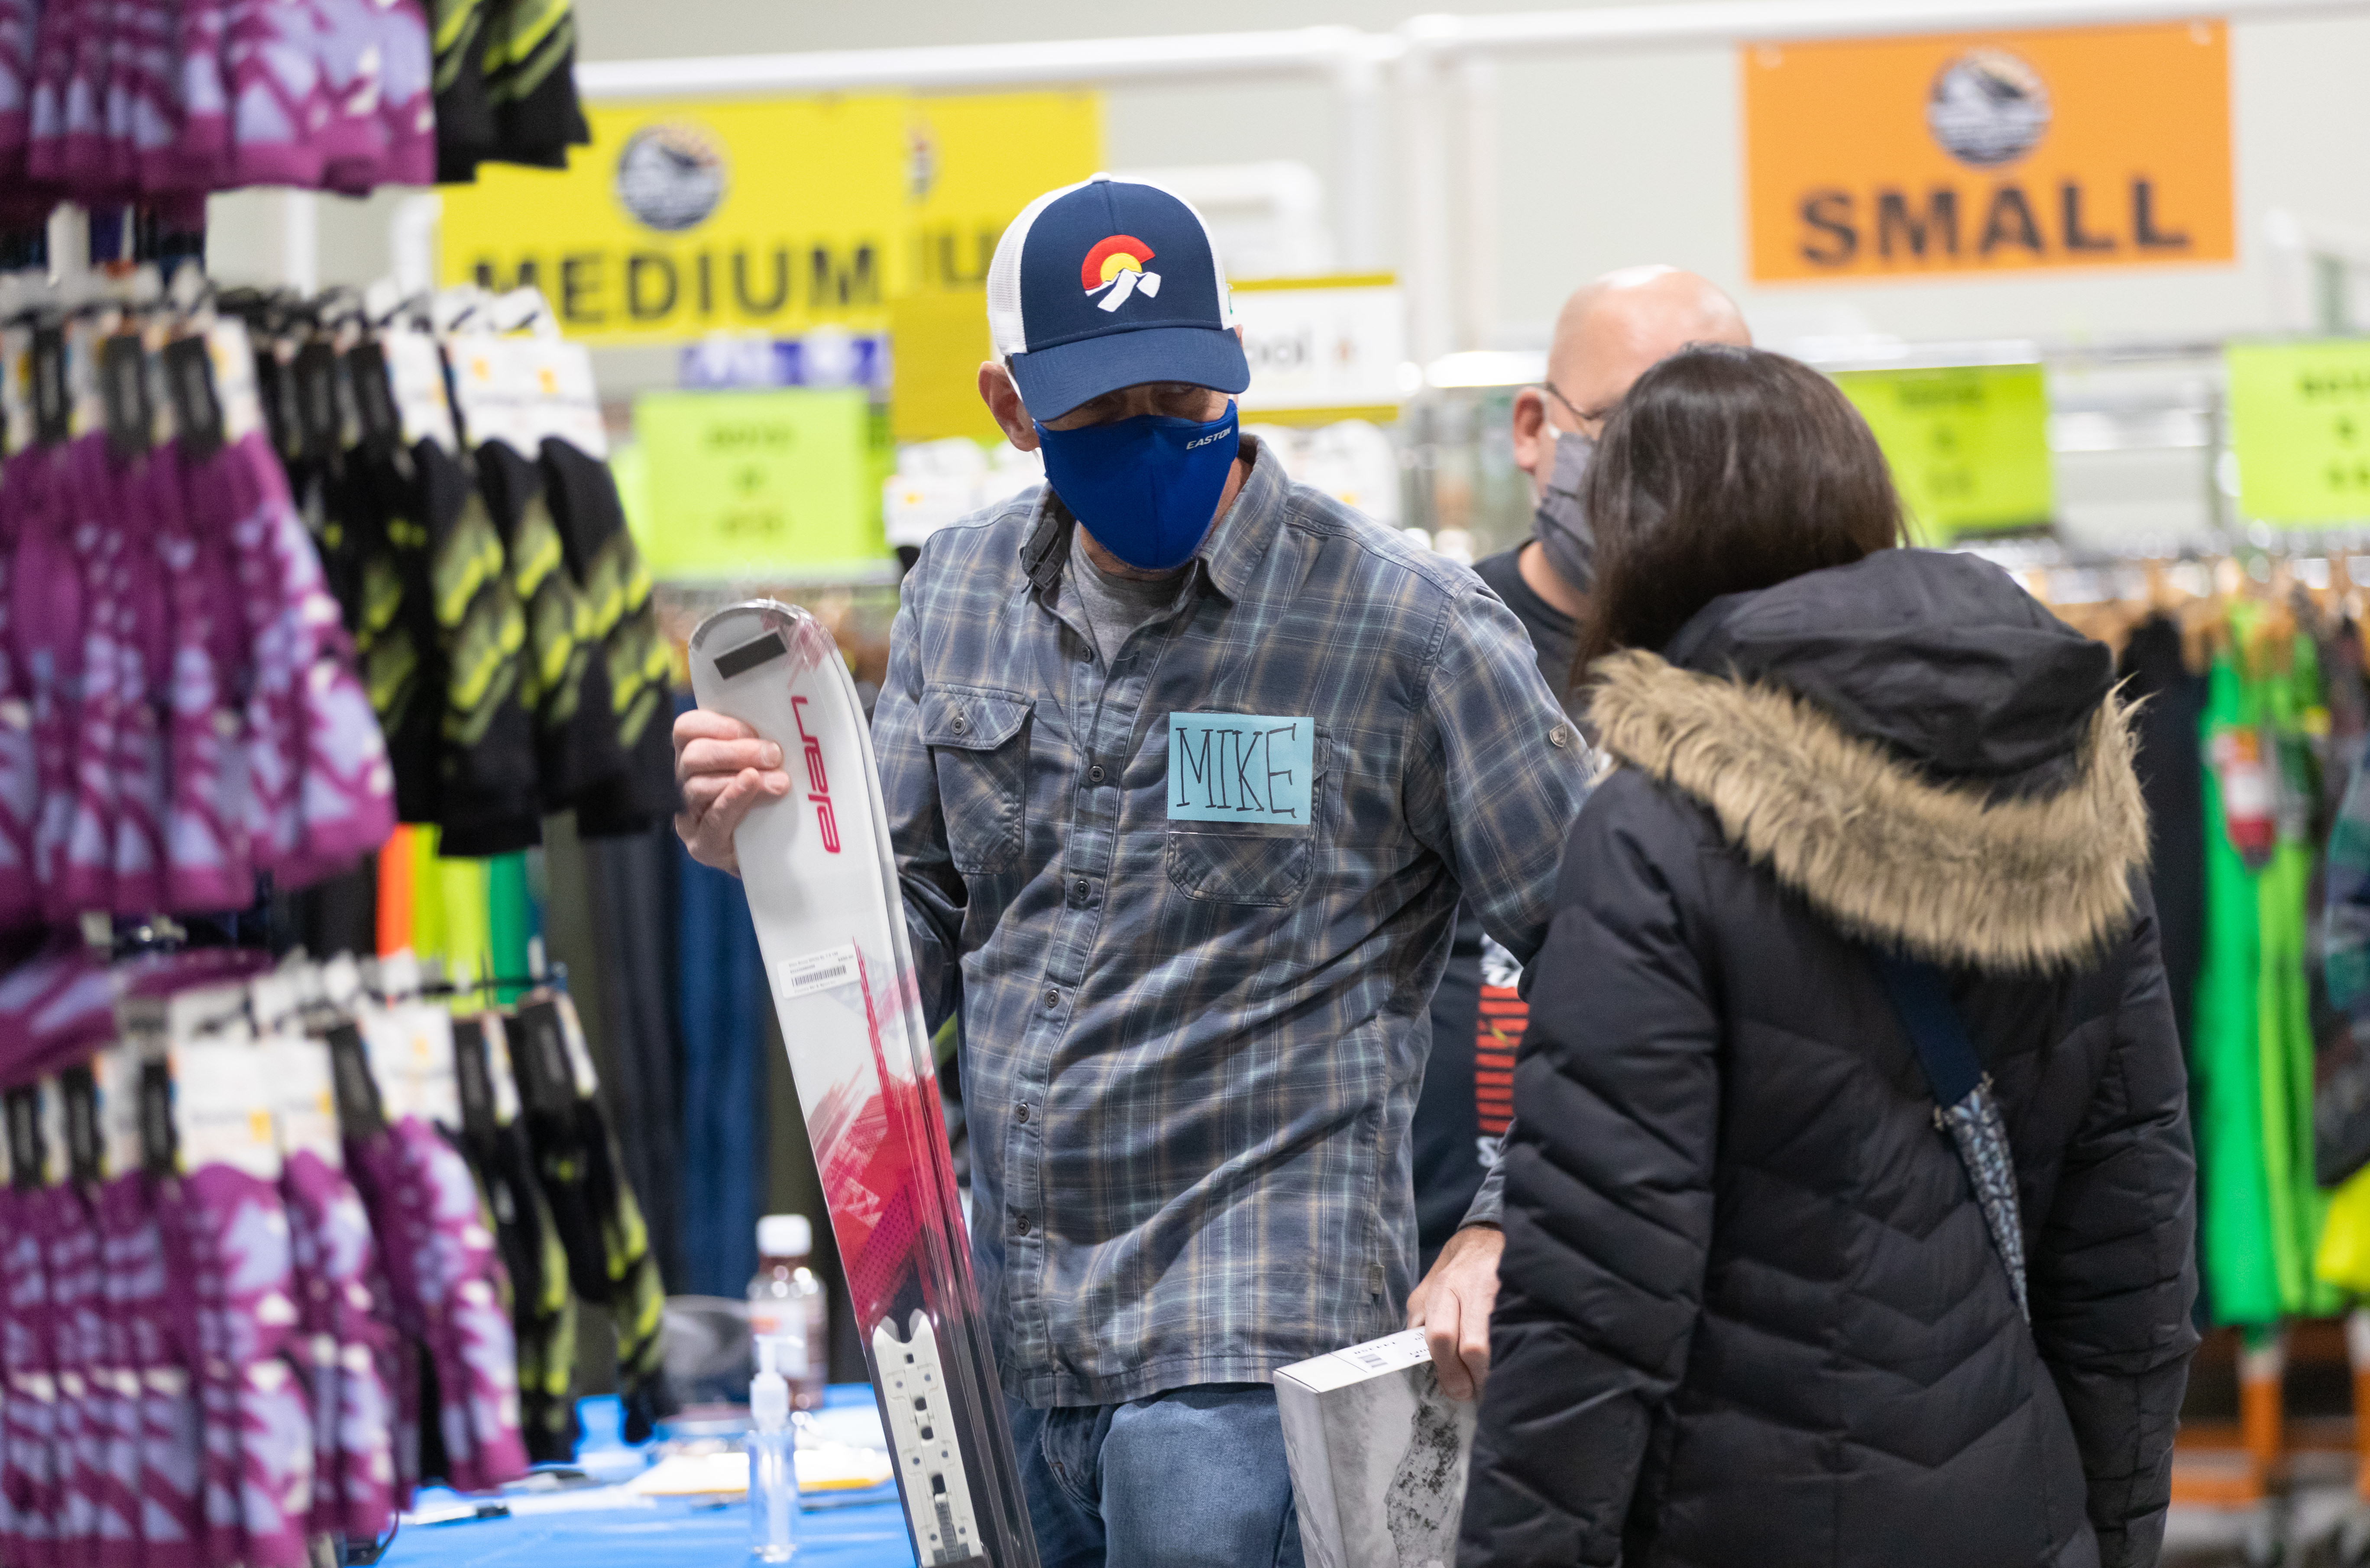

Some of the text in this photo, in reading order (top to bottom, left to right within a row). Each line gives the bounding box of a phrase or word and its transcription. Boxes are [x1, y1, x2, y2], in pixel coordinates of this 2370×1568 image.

[1797, 178, 2191, 266] SMALL
[1186, 426, 1232, 450] EASTON
[1175, 723, 1297, 818] MIKE
